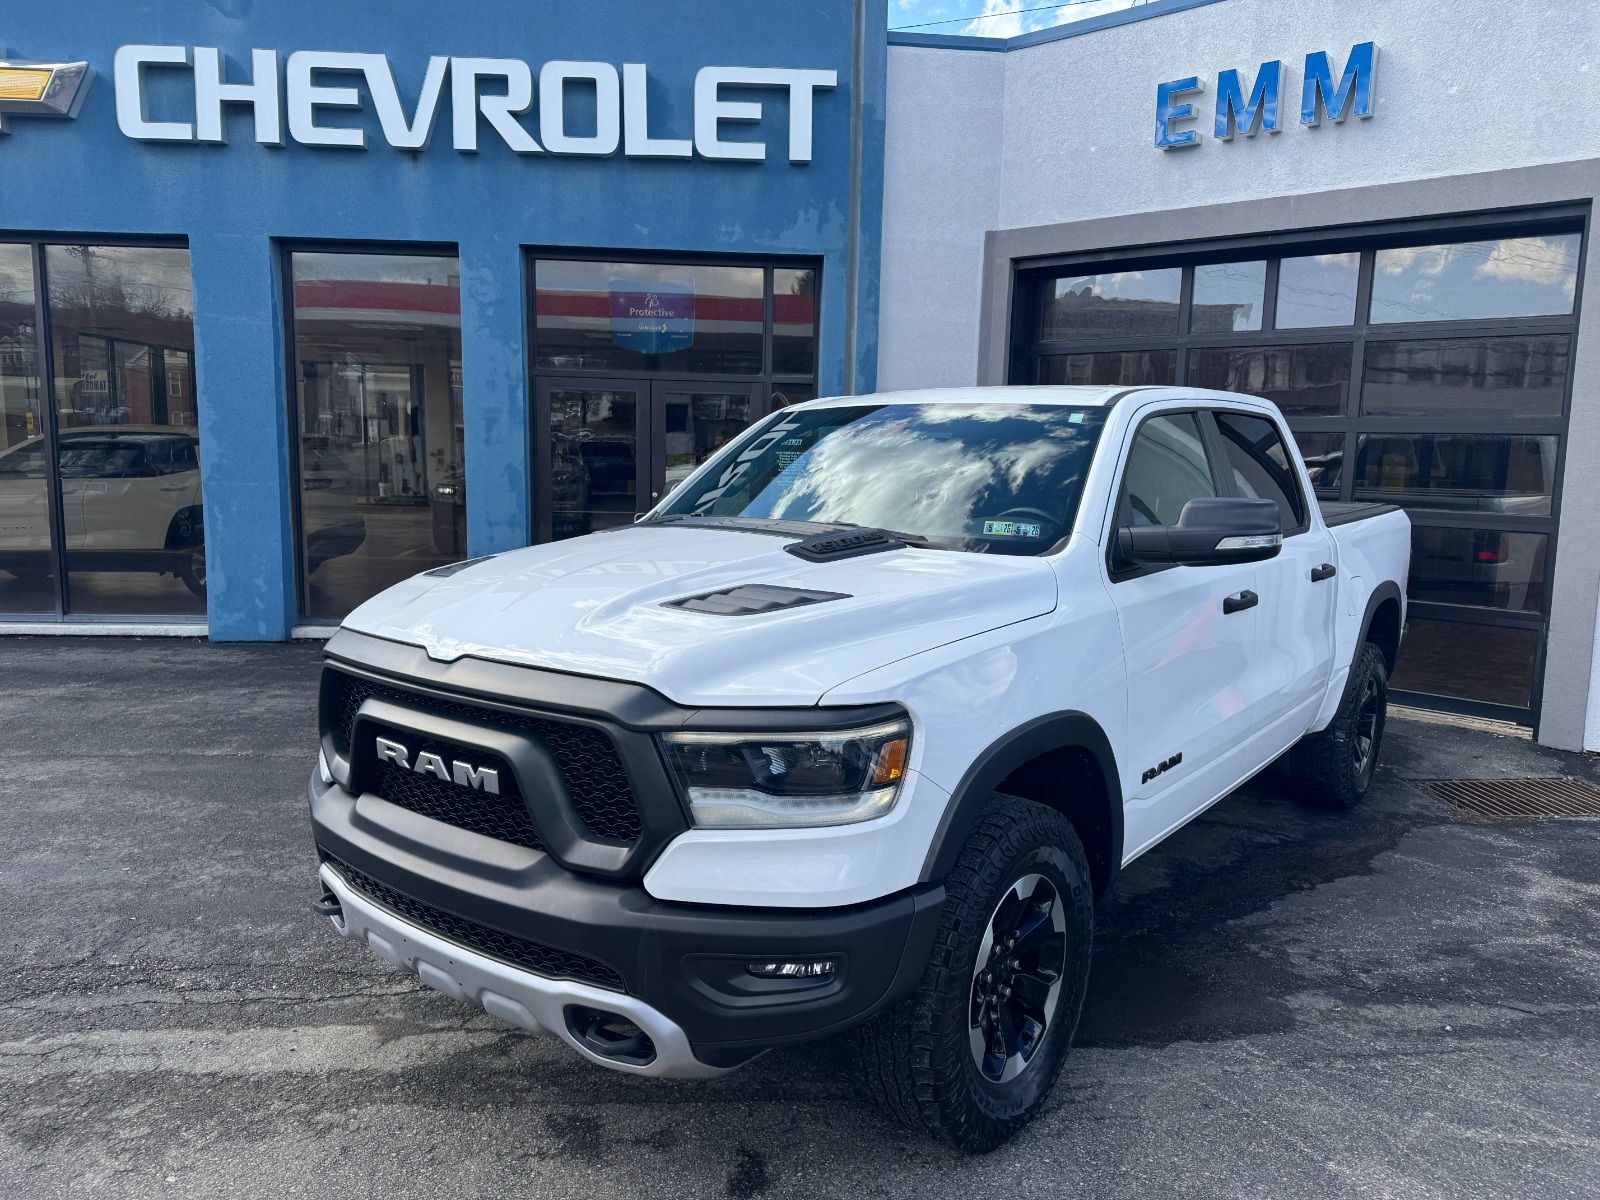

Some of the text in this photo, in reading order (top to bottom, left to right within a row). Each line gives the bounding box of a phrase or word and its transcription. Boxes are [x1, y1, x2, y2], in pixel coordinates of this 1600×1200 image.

[114, 45, 838, 164] CHEVROLET
[1155, 41, 1380, 150] EMM
[629, 307, 675, 317] Protective
[811, 534, 865, 552] 1500
[375, 735, 500, 795] RAM
[1141, 751, 1183, 785] RAM
